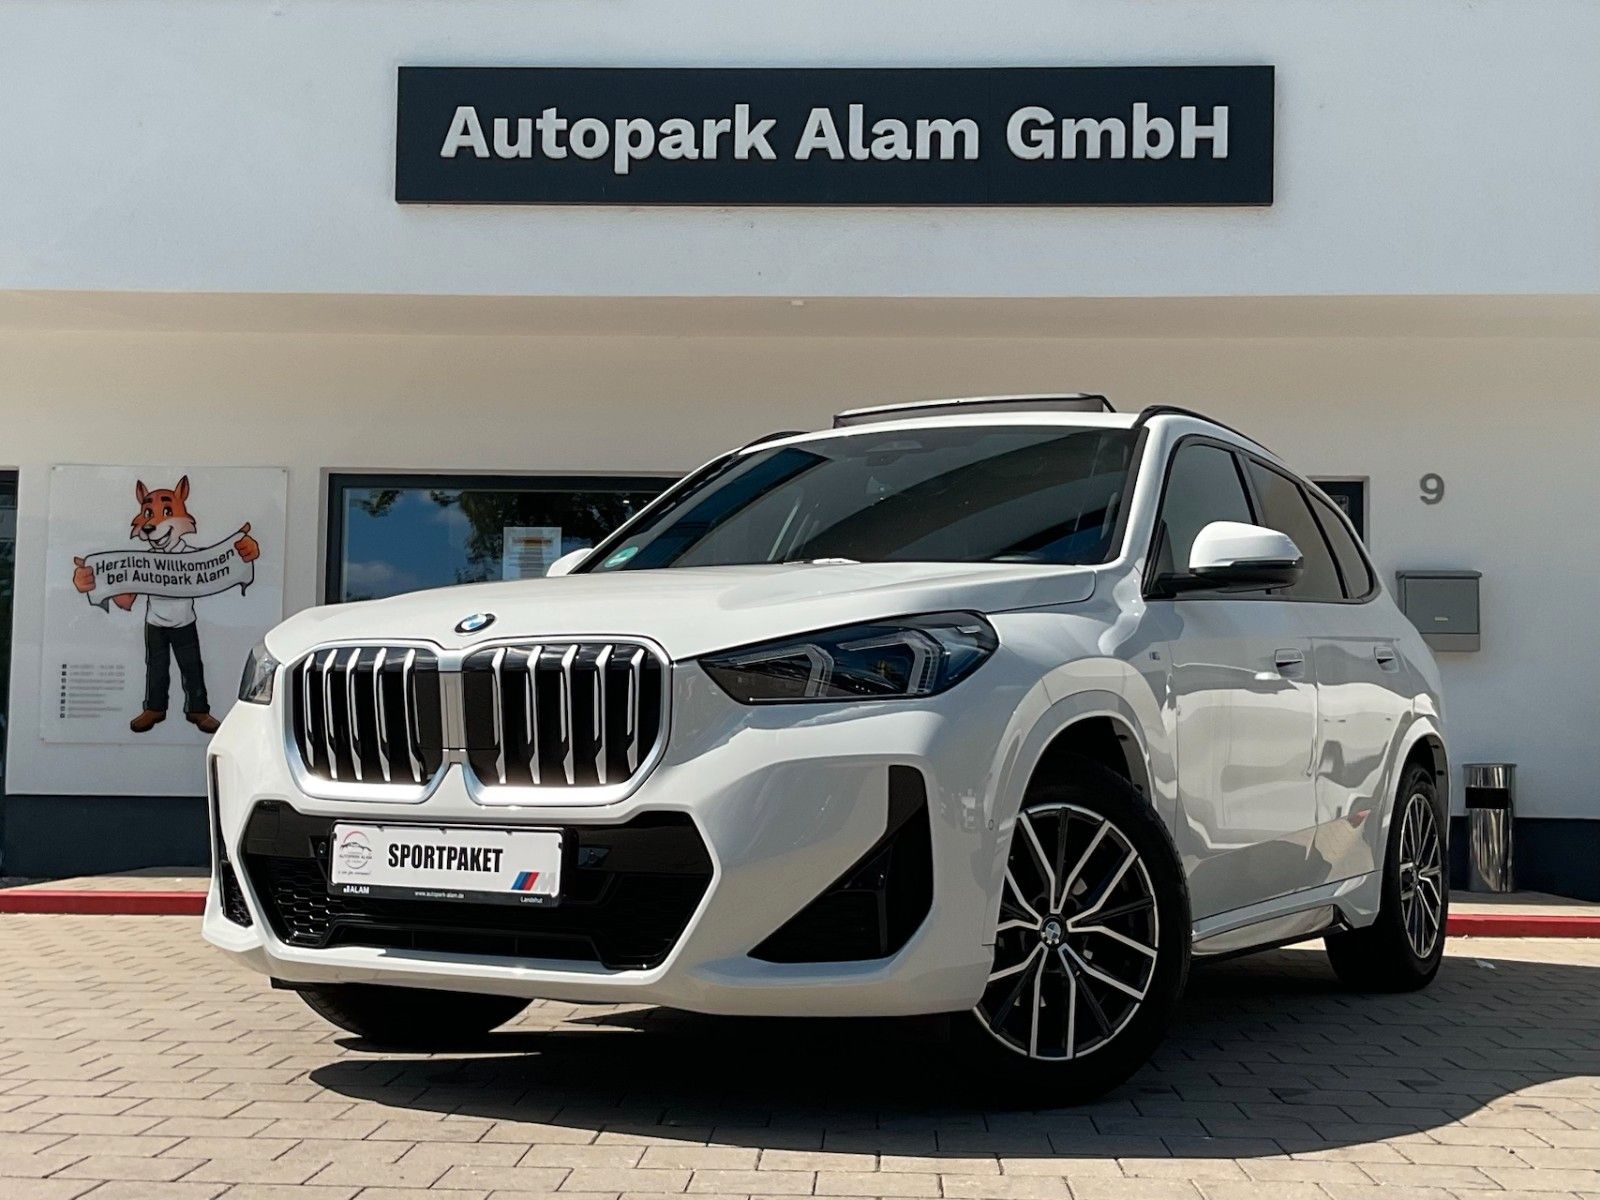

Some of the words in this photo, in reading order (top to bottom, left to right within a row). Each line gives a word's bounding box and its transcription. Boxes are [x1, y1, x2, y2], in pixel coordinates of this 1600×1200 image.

[440, 103, 777, 175] Autopark
[794, 103, 979, 161] Alam
[1006, 102, 1229, 160] GmbH
[1419, 473, 1445, 505] 9
[96, 556, 151, 575] Herzlich
[153, 549, 235, 572] Willkommen
[107, 569, 128, 585] bei
[132, 570, 192, 586] Autopark
[196, 566, 230, 584] Alam
[388, 843, 504, 872] SPORTPAKET
